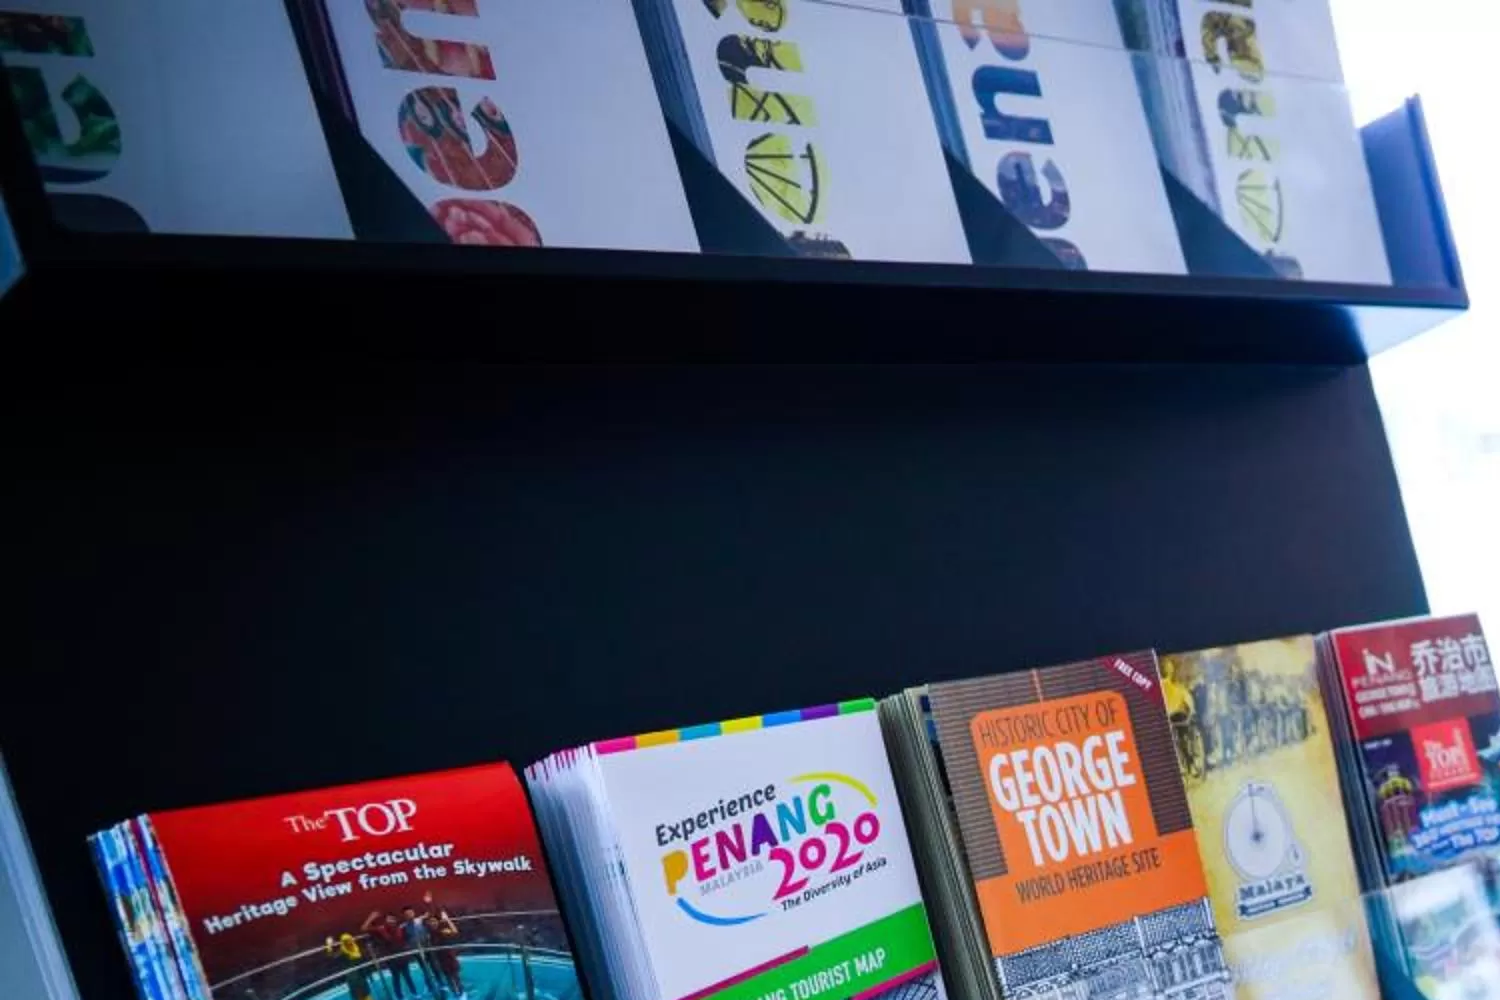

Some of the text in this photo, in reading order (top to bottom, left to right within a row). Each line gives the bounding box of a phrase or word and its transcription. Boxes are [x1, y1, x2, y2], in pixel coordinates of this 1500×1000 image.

[978, 698, 1118, 748] HISTORIC CITY OF
[989, 730, 1136, 813] GEORGE
[284, 797, 418, 843] The TOP
[655, 783, 776, 847] Experience
[661, 783, 835, 896] PENANG
[1016, 790, 1134, 868] TOWN
[281, 841, 456, 888] A Spectacular
[700, 860, 764, 896] MALAYSIA
[768, 811, 881, 901] 2020
[781, 857, 887, 912] The Diversity of Asia
[1015, 847, 1162, 905] WORLD HERITAGE SITE
[202, 856, 533, 935] Heritage View from the Skywalk
[854, 947, 887, 982] MAP
